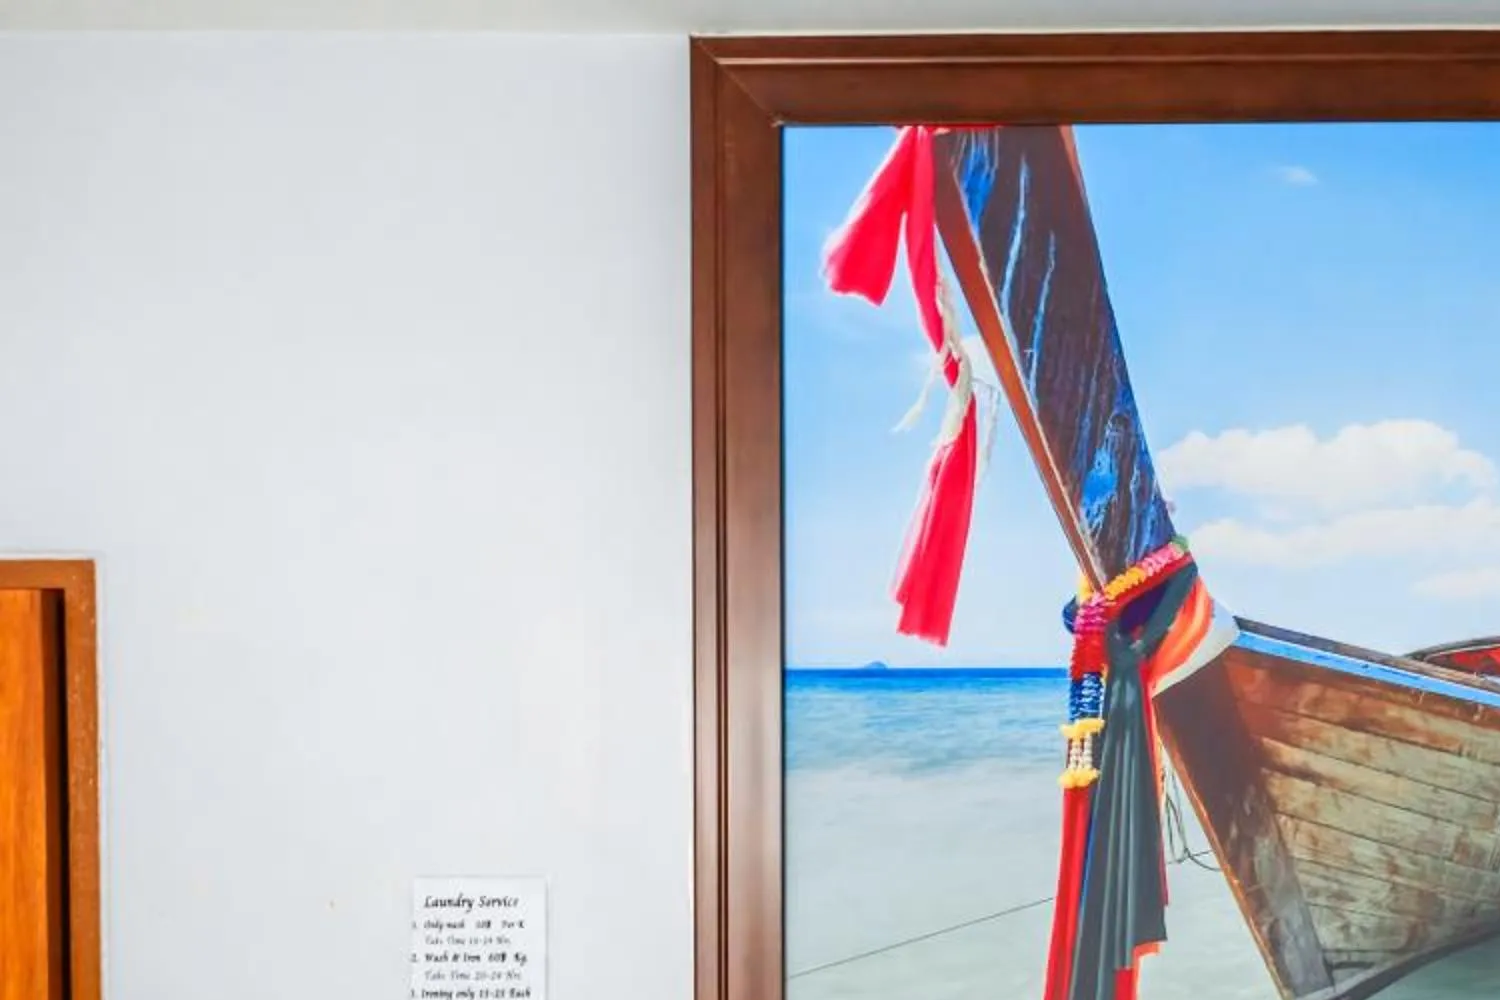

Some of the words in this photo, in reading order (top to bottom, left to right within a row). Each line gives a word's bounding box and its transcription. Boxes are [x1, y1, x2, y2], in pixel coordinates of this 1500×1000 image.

[424, 891, 474, 913] Laundry
[478, 895, 519, 908] Service
[425, 951, 448, 962] Wash
